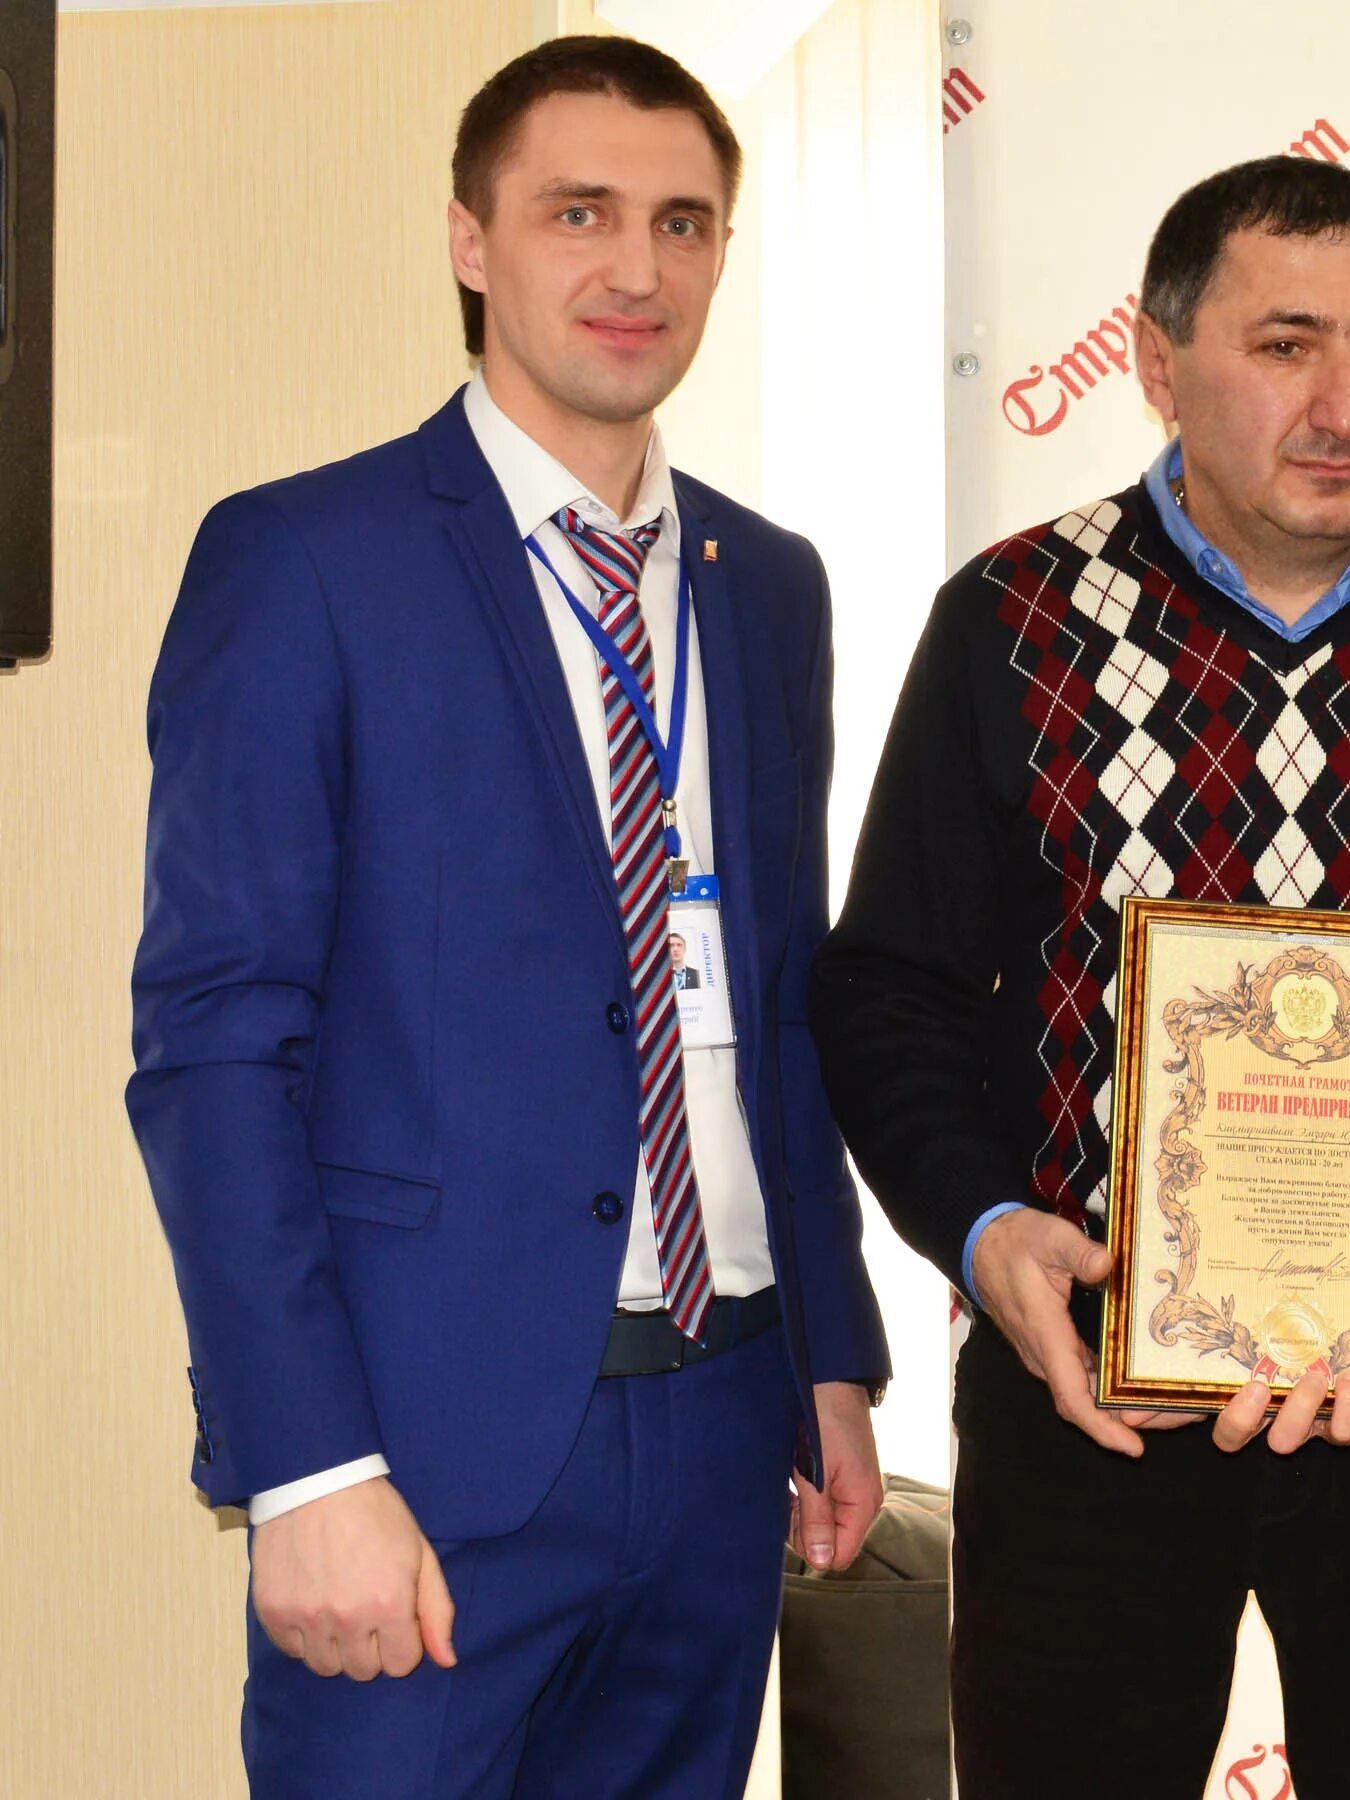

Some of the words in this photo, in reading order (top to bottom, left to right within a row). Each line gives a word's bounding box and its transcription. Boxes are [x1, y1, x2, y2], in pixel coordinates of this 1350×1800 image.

[1244, 1073, 1305, 1089] ПОЧЕТНАЯ
[1217, 1091, 1279, 1115] ВЕТЕРАН
[1248, 1144, 1312, 1156] ПРИСУЖДАЕТСЯ
[1314, 1149, 1326, 1157] ПО
[1255, 1156, 1283, 1165] СТАЖА
[1284, 1157, 1317, 1167] РАБОТЫ
[1216, 1173, 1258, 1183] Выражаем
[1260, 1176, 1277, 1184] Вам
[1221, 1193, 1269, 1204] Благодарим
[1234, 1215, 1265, 1223] Желаем
